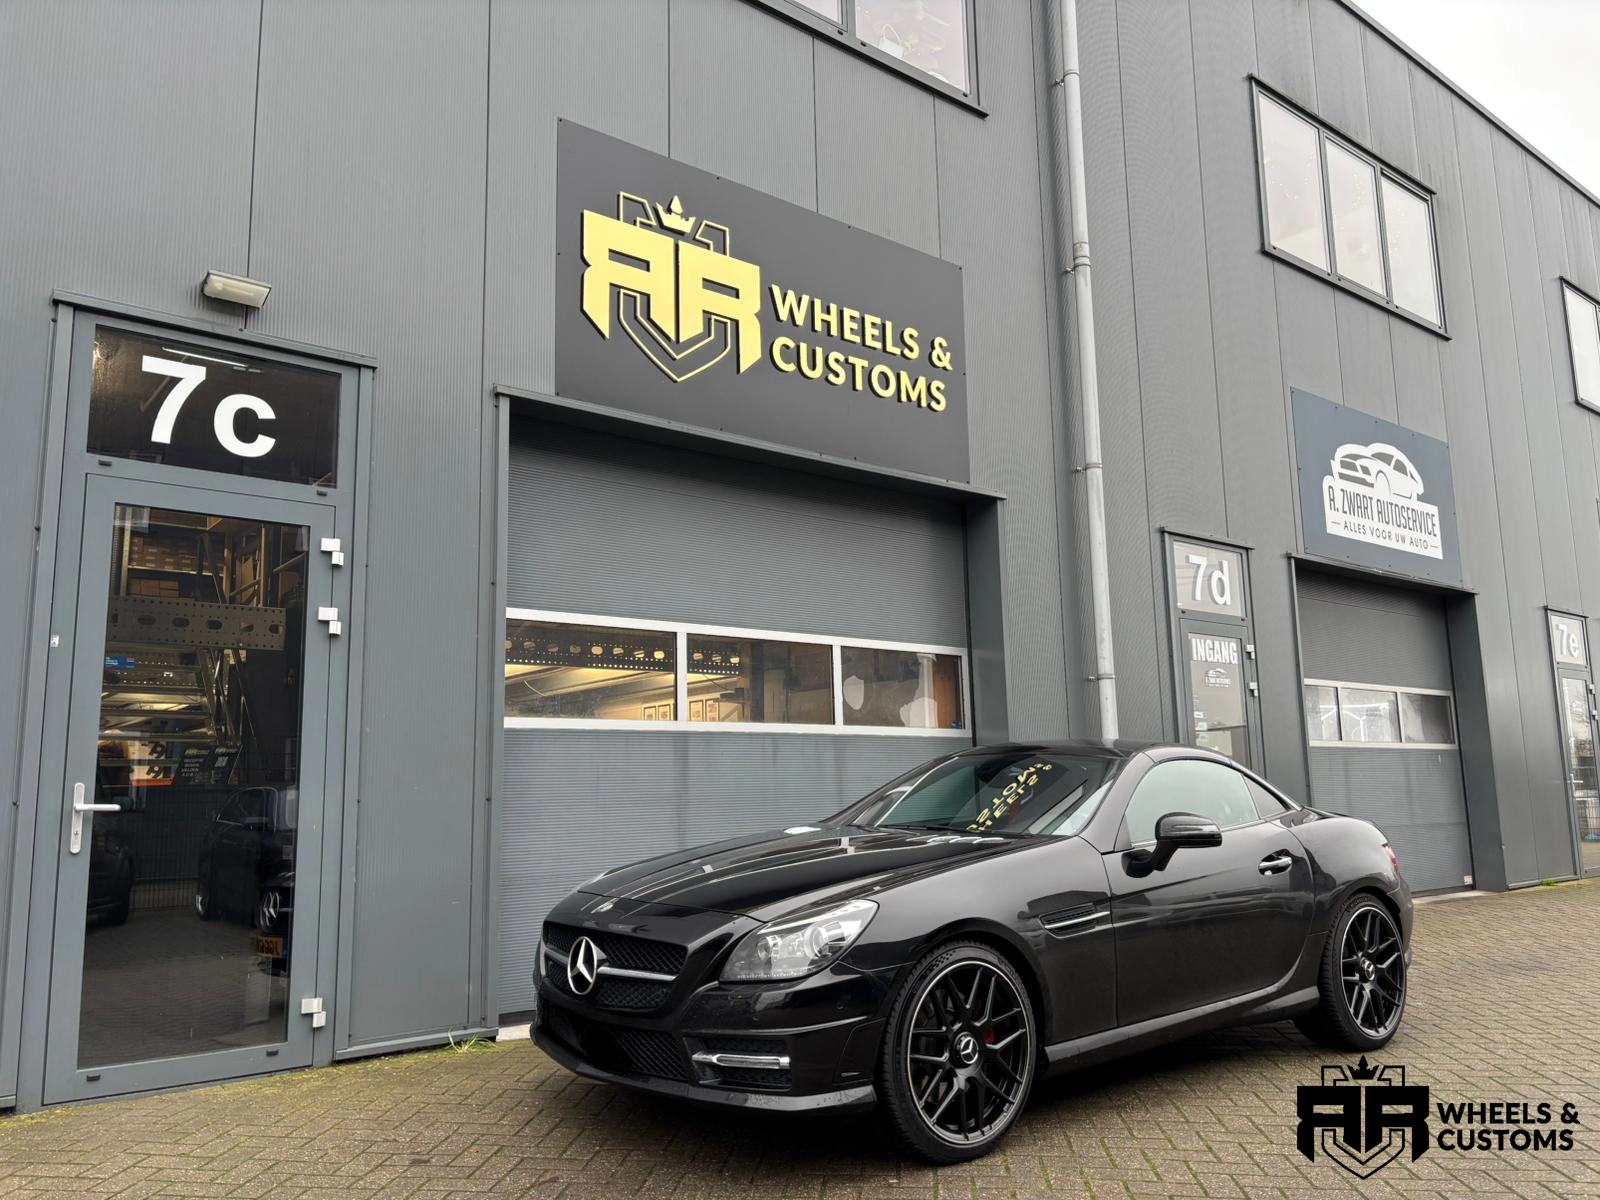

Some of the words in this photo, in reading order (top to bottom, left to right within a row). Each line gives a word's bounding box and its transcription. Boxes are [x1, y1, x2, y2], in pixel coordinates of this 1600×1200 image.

[772, 284, 920, 359] WHEELS
[931, 336, 953, 370] &
[771, 337, 947, 411] CUSTOMS
[142, 355, 276, 458] 7c
[1328, 485, 1339, 512] A.
[1340, 489, 1374, 521] ZWART
[1376, 499, 1437, 537] AUTOSERVICE
[1344, 521, 1366, 535] ALLES
[1369, 527, 1392, 540] VOOR
[1395, 533, 1406, 544] UW
[1409, 537, 1429, 549] AUTO
[1188, 554, 1232, 605] 7d
[1191, 637, 1238, 665] INGANG
[1557, 624, 1579, 658] 7e
